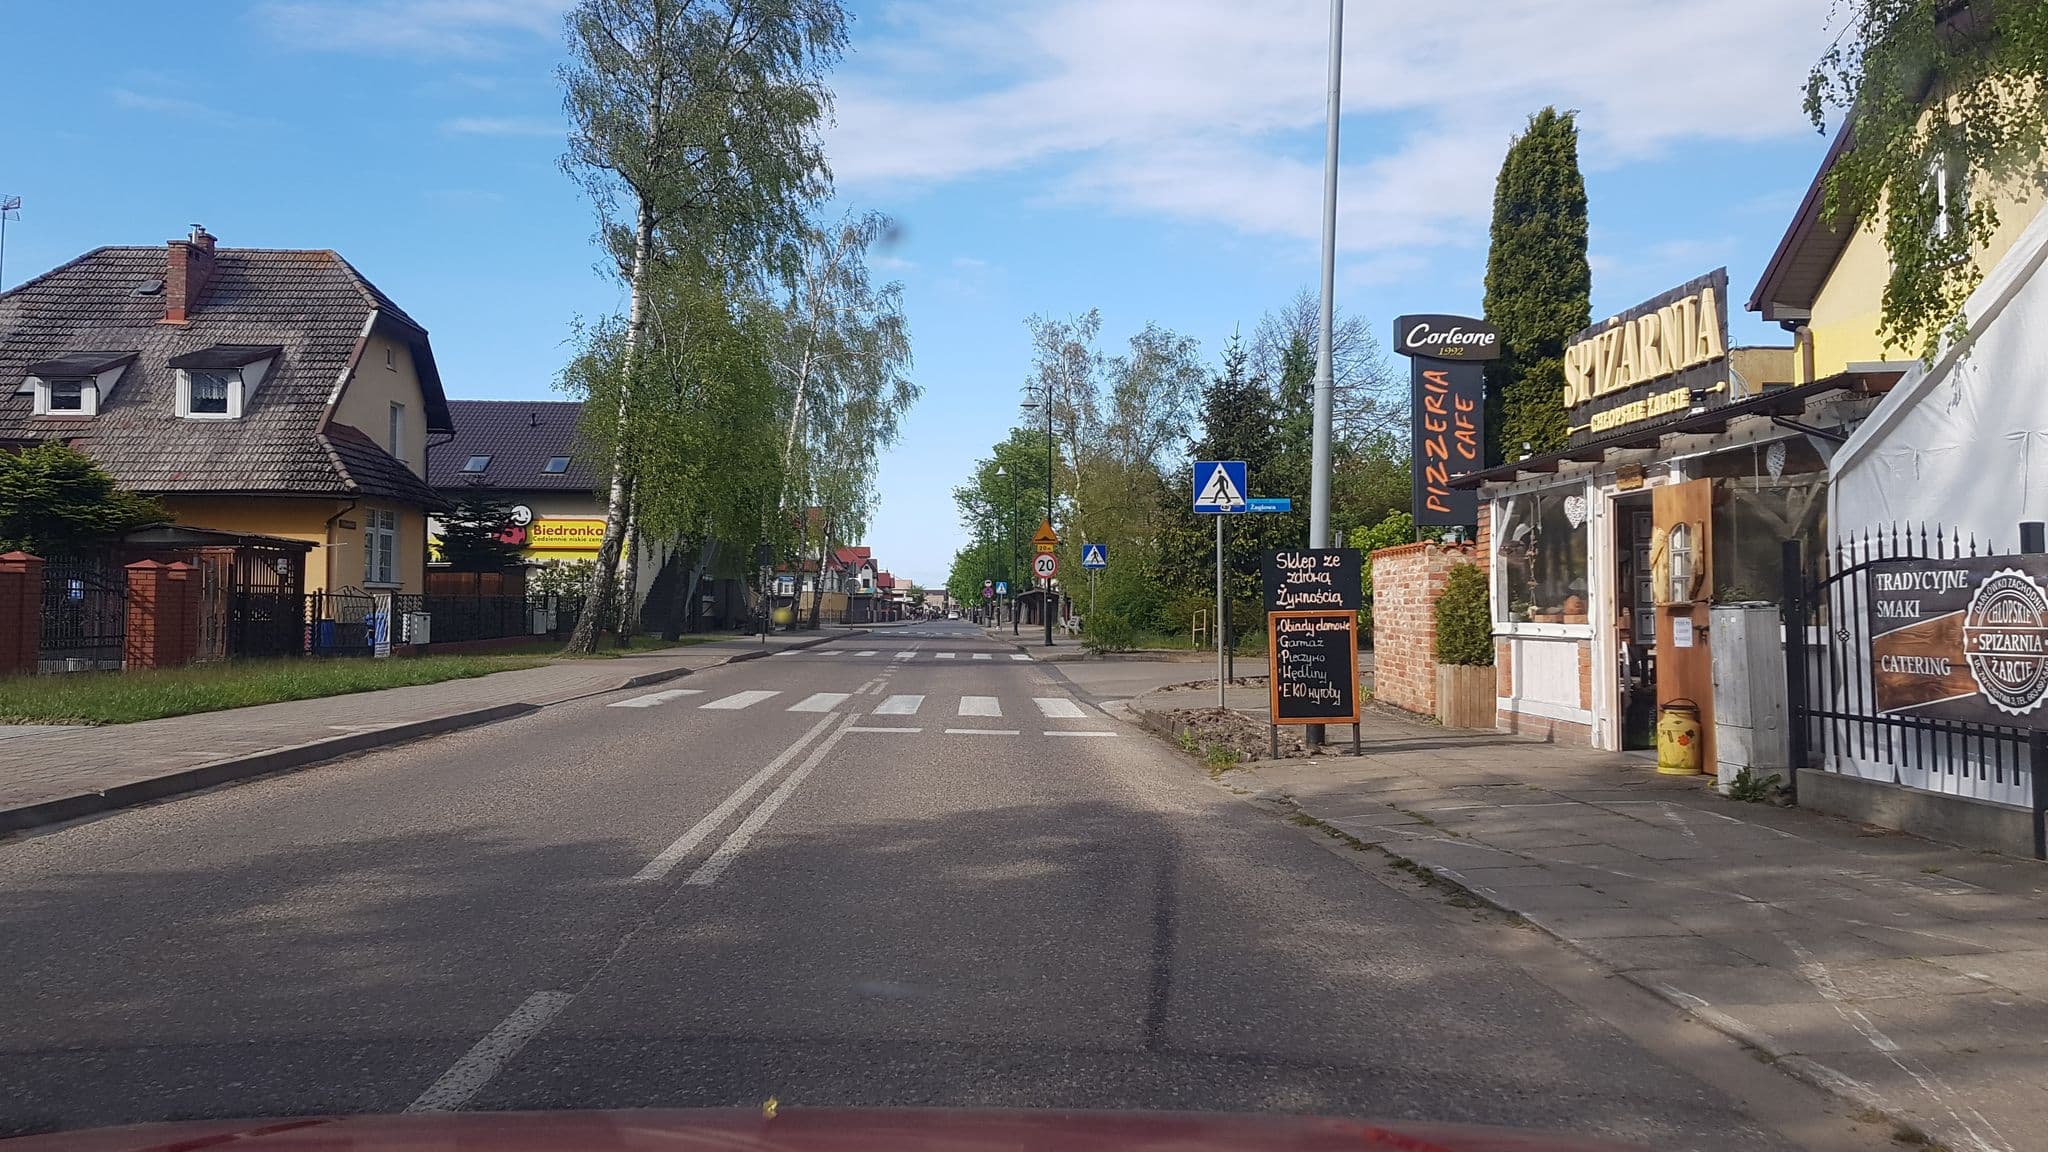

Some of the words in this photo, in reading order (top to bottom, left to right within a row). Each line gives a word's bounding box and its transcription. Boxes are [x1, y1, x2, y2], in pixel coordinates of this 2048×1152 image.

[1406, 323, 1496, 348] Corleone
[1438, 346, 1464, 356] 1992
[1563, 287, 1725, 408] SPIŻARNIA
[1454, 392, 1477, 460] CAFE
[1422, 369, 1451, 513] PIZZERIA
[533, 524, 604, 536] Biedronka
[1038, 560, 1055, 572] 20
[1276, 552, 1317, 574] Sklep
[1323, 555, 1341, 567] ze
[1287, 569, 1332, 585] zdrową
[1876, 570, 1969, 594] TRADYCYJNE
[1276, 584, 1344, 609] Żywnością
[2007, 578, 2046, 614] ZACHODNIE
[1877, 600, 1921, 618] SMAKI
[1280, 618, 1315, 637] Obiady
[1315, 617, 1350, 631] domowe
[1979, 630, 2043, 652] SPIŻARNIA
[1281, 649, 1325, 666] Pieczywo
[1881, 655, 1951, 676] CATERING
[1283, 665, 1328, 684] Wędliny
[1991, 657, 2034, 682] ŻARCIE
[1283, 682, 1307, 697] EKO
[1308, 681, 1341, 705] wyroby
